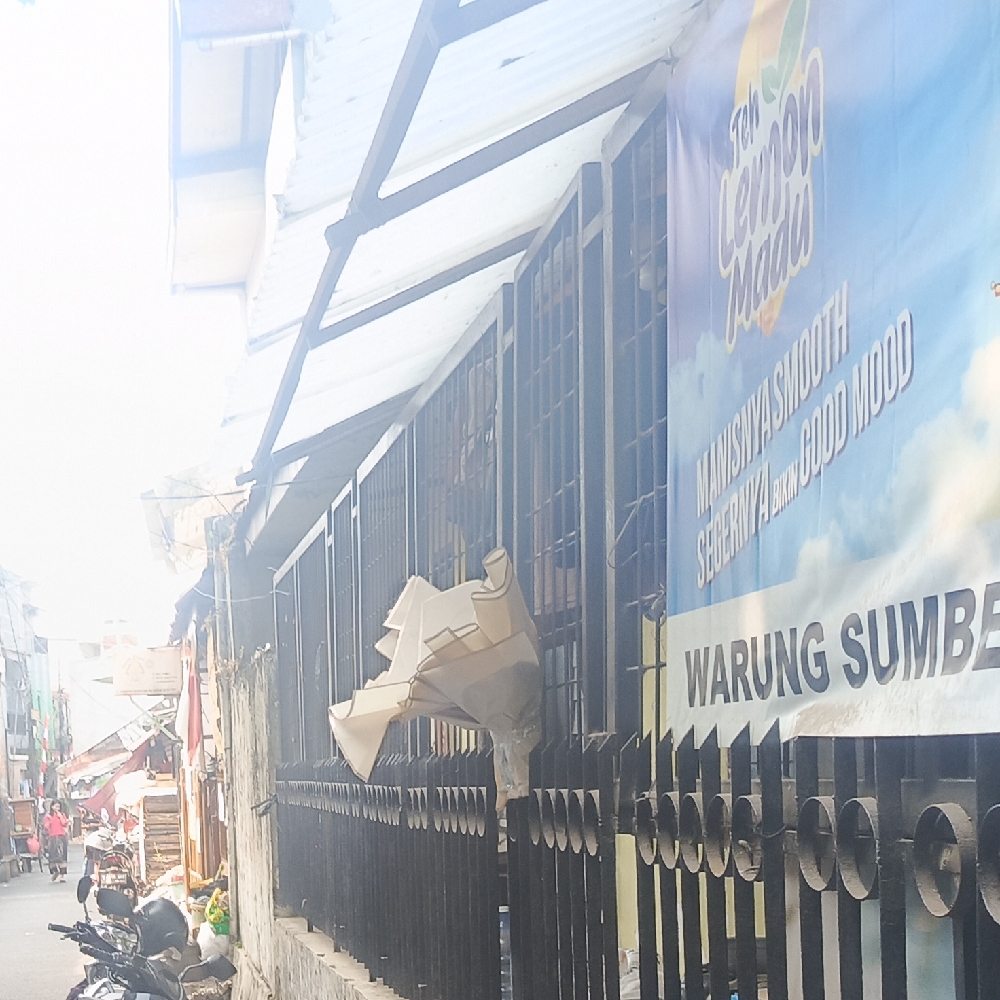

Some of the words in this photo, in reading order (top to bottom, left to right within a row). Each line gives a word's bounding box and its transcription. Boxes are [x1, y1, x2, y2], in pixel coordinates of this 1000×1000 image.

[720, 54, 823, 272] Lemon
[731, 81, 760, 169] Teh
[728, 180, 812, 347] Madu
[697, 377, 772, 518] MANISNYA
[773, 280, 848, 431] SMOOTH
[697, 461, 770, 588] SEGERNYA
[772, 459, 799, 517] BIKIN
[801, 380, 848, 487] GOOD
[853, 308, 914, 438] MOOD
[685, 622, 830, 708] WARUNG
[840, 581, 1000, 689] SUMBE
